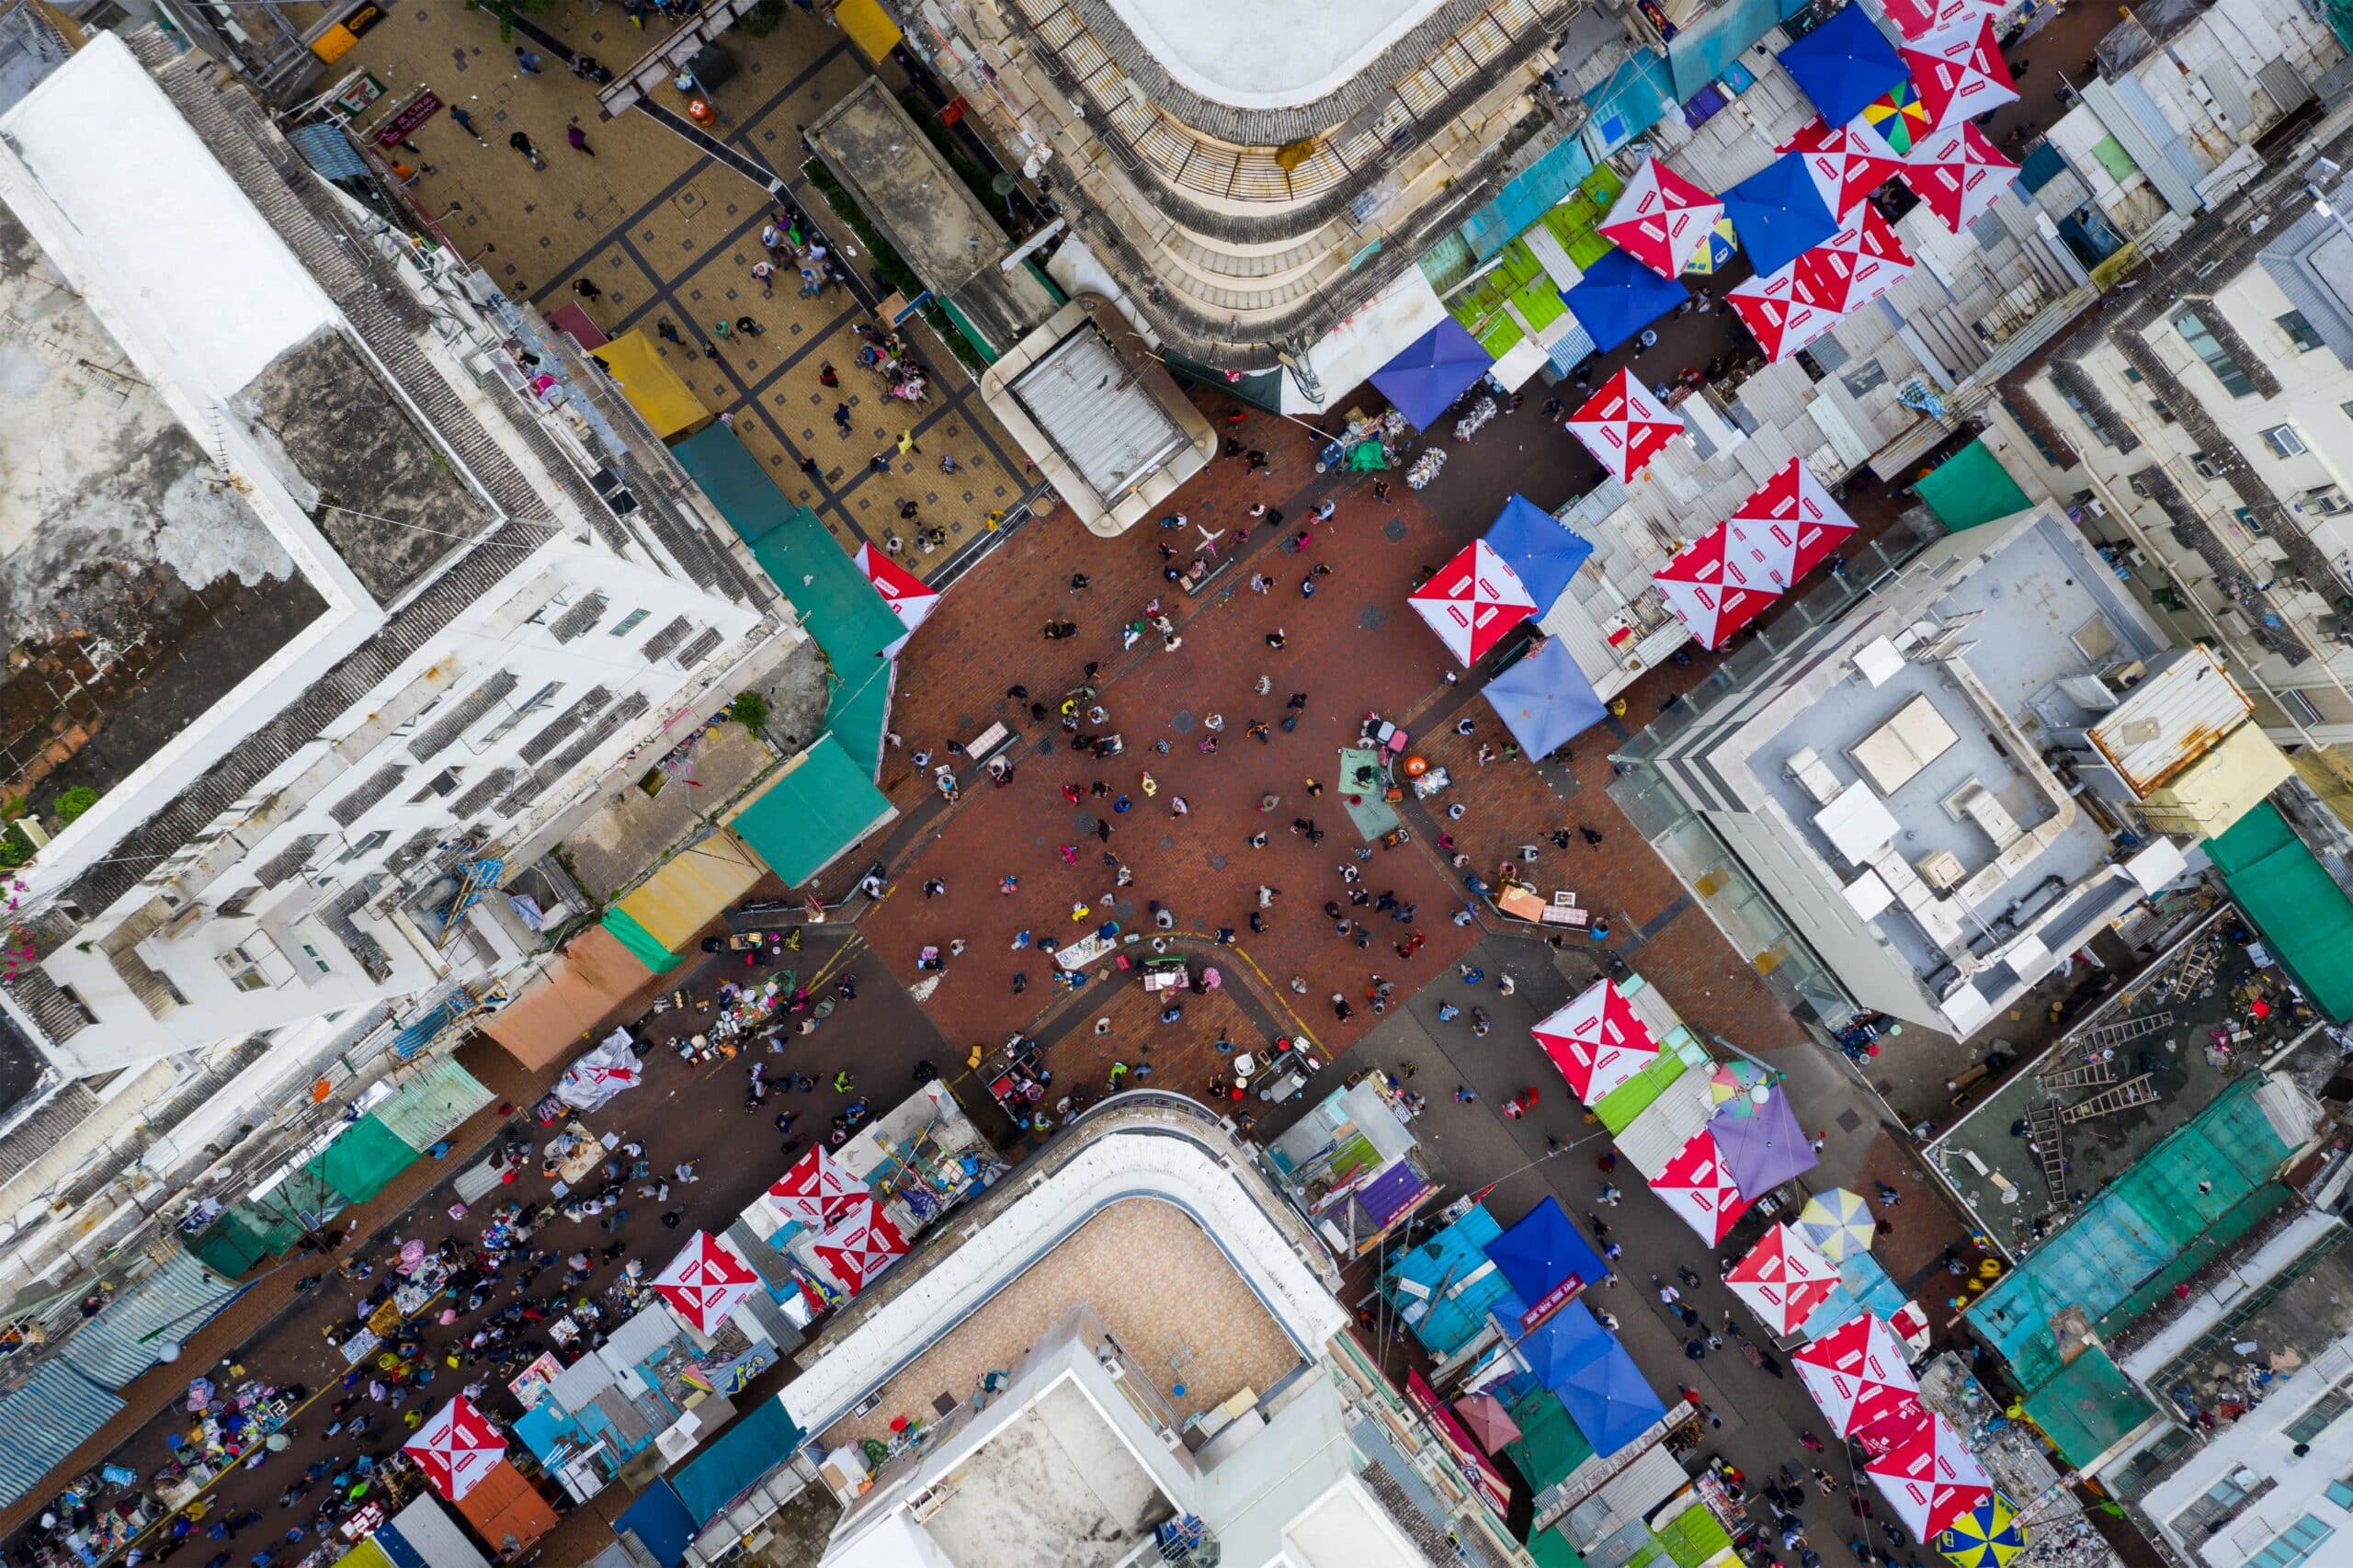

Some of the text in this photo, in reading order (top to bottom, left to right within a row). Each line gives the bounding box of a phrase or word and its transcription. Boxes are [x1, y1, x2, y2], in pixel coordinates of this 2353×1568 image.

[1941, 2, 1963, 19] Lenovo
[1945, 41, 1969, 56] Lenovo
[1938, 65, 1952, 90] Lenovo
[345, 82, 374, 106] 7
[1961, 82, 1984, 97] Lenovo
[415, 100, 437, 119] SHOP
[1820, 131, 1841, 149] Lenovo
[1851, 133, 1870, 153] Lenovo
[1938, 141, 1958, 160] Lenovo
[1818, 158, 1836, 180] Lenovo
[1847, 162, 1869, 181] Lenovo
[1937, 169, 1957, 189] Lenovo
[1967, 171, 1985, 191] Lenovo
[1638, 191, 1656, 213] Lenovo
[1641, 222, 1664, 240] Lenovo
[1672, 214, 1689, 238] Lenovo
[1834, 229, 1856, 245] Lenovo
[1831, 255, 1847, 277] Lenovo
[1856, 264, 1878, 280] Lenovo
[1765, 278, 1788, 295] Lenovo
[1764, 303, 1780, 326] Lenovo
[1790, 311, 1811, 328] Lenovo
[1602, 398, 1621, 418] Lenovo
[1631, 399, 1651, 418] Lenovo
[1601, 426, 1621, 448] Lenovo
[1631, 427, 1651, 449] Lenovo
[1773, 497, 1794, 516] Lenovo
[1803, 498, 1823, 519] Lenovo
[1771, 526, 1790, 546] Lenovo
[1801, 528, 1821, 548] Lenovo
[1698, 562, 1718, 578] Lenovo
[1728, 562, 1745, 584] Lenovo
[877, 578, 897, 596] Lenovo
[1451, 576, 1471, 596] Lenovo
[1481, 579, 1499, 600] Lenovo
[1695, 588, 1713, 609] Lenovo
[1724, 593, 1745, 611] Lenovo
[1449, 607, 1467, 627] Lenovo
[1477, 608, 1497, 627] Lenovo
[1575, 1017, 1597, 1035] Lenovo
[1573, 1044, 1590, 1066] Lenovo
[1598, 1052, 1619, 1069] Lenovo
[1693, 1162, 1711, 1182] Lenovo
[801, 1175, 818, 1194] Lenovo
[824, 1173, 843, 1193] Lenovo
[1692, 1192, 1711, 1210] Lenovo
[845, 1228, 867, 1245] Lenovo
[873, 1230, 889, 1250] Lenovo
[680, 1261, 699, 1281] Lenovo
[707, 1261, 726, 1281] Lenovo
[844, 1252, 860, 1271] Lenovo
[866, 1256, 888, 1273] Lenovo
[1761, 1257, 1779, 1277] Lenovo
[1790, 1256, 1807, 1277] Lenovo
[680, 1288, 699, 1307] Lenovo
[706, 1289, 725, 1307] Lenovo
[1761, 1287, 1780, 1305] Lenovo
[1838, 1351, 1861, 1368] Lenovo
[1870, 1356, 1885, 1379] Lenovo
[1835, 1375, 1850, 1399] Lenovo
[431, 1426, 450, 1445] Lenovo
[458, 1426, 476, 1447] Lenovo
[455, 1453, 475, 1471] Lenovo
[1910, 1454, 1930, 1472] Lenovo
[1939, 1457, 1955, 1479] Lenovo
[1907, 1483, 1925, 1506] Lenovo
